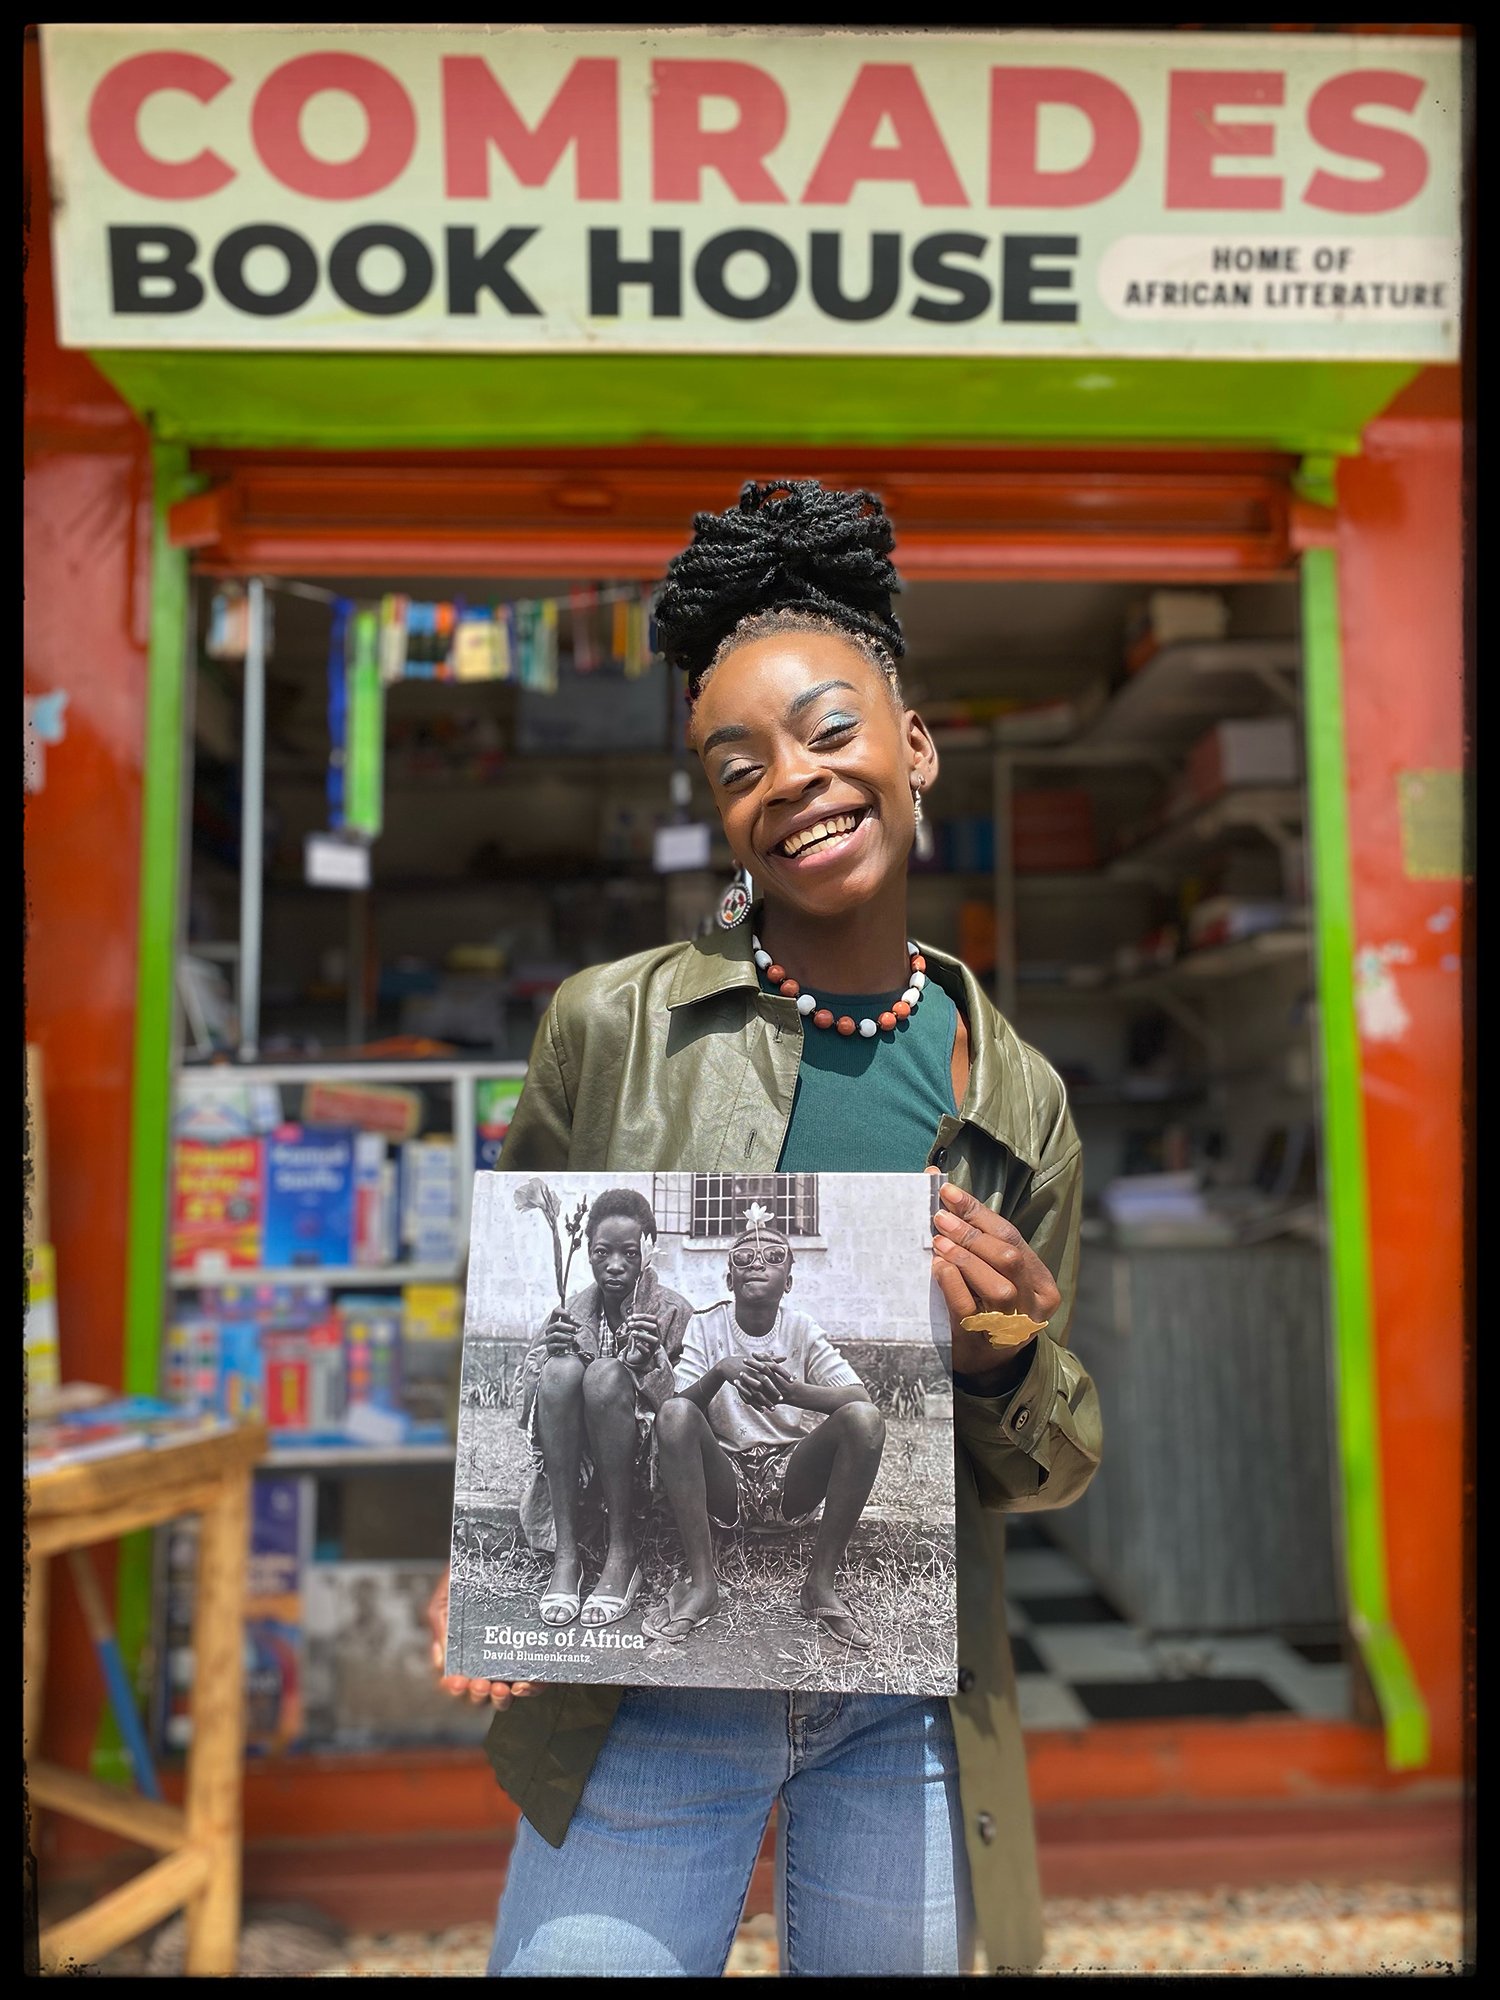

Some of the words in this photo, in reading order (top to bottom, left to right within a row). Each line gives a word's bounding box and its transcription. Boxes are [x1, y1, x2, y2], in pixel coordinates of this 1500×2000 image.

[88, 50, 1429, 214] COMRADES
[1212, 247, 1298, 272] HOME
[1313, 248, 1352, 272] OF
[107, 223, 543, 318] BOOK
[588, 227, 1080, 325] HOUSE
[1124, 281, 1252, 307] AFRICAN
[1264, 282, 1448, 308] LITERATURE
[484, 1626, 548, 1648] Edges
[554, 1628, 576, 1647] of
[580, 1629, 646, 1649] Africa
[483, 1650, 514, 1661] David
[516, 1651, 592, 1663] Blumenkrantz
